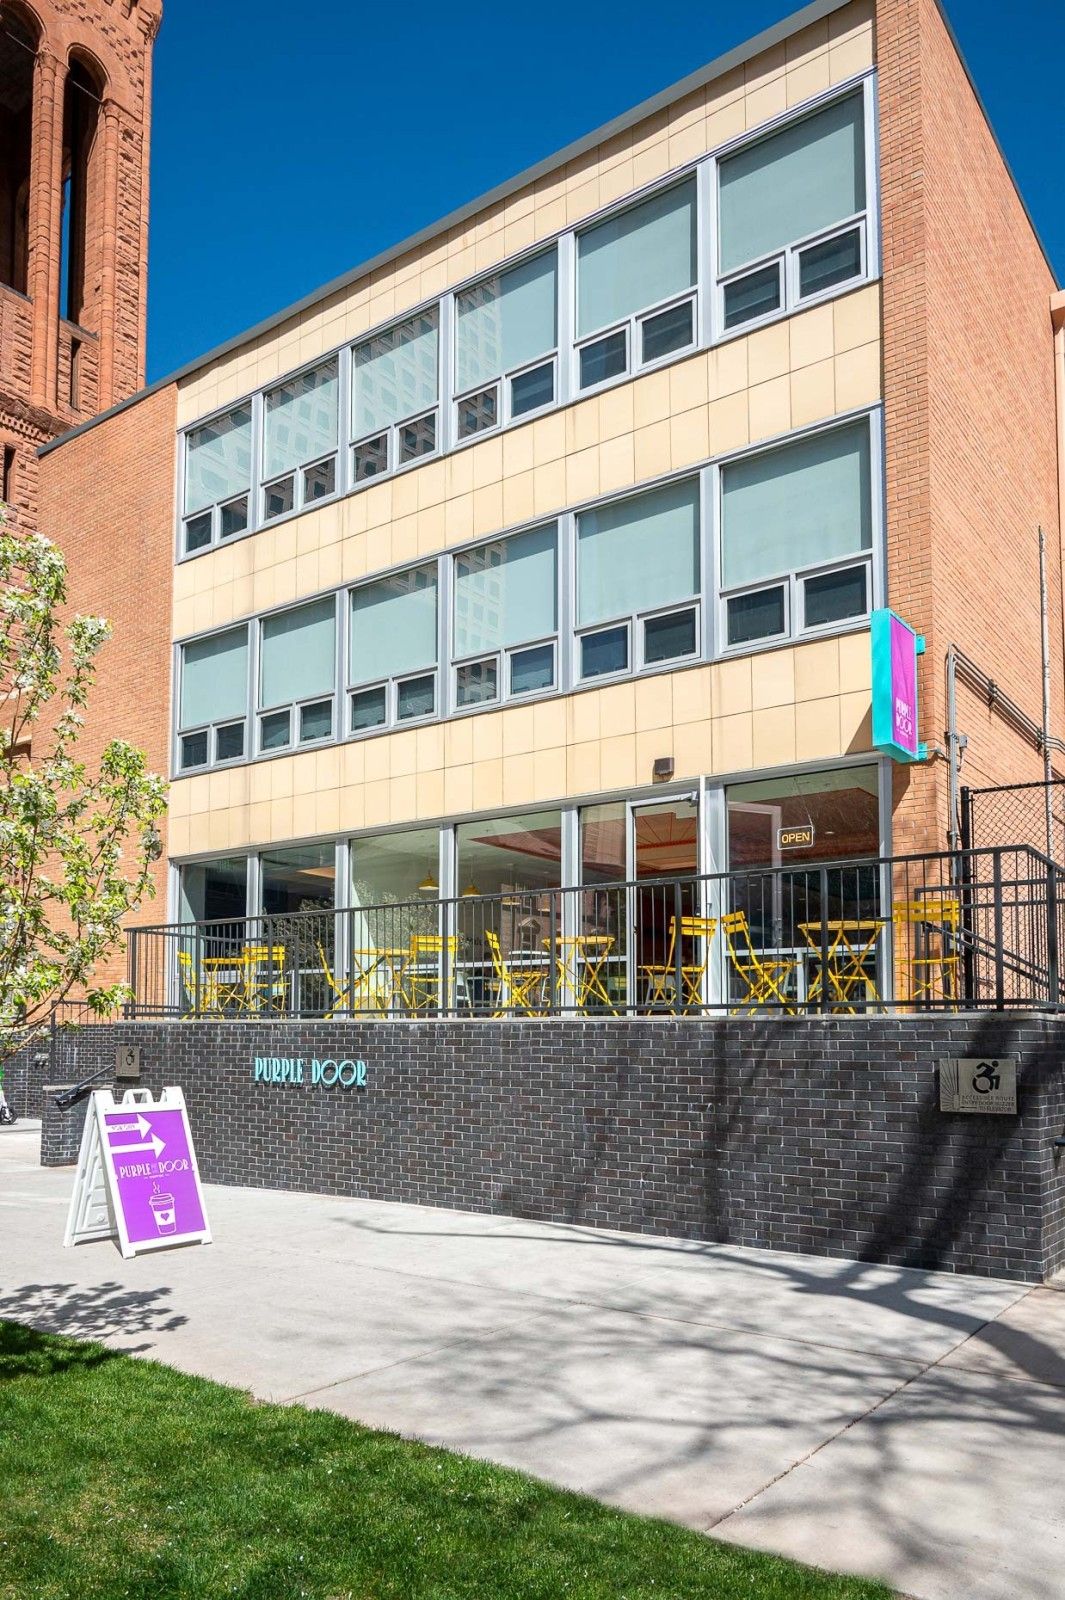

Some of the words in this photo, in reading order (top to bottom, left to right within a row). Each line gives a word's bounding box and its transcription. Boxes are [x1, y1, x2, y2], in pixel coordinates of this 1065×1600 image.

[781, 831, 810, 844] OPEN
[254, 1057, 304, 1083] PURPLE
[311, 1059, 367, 1087] DOOR
[119, 1163, 152, 1179] PURPLE
[158, 1159, 189, 1173] DOOR
